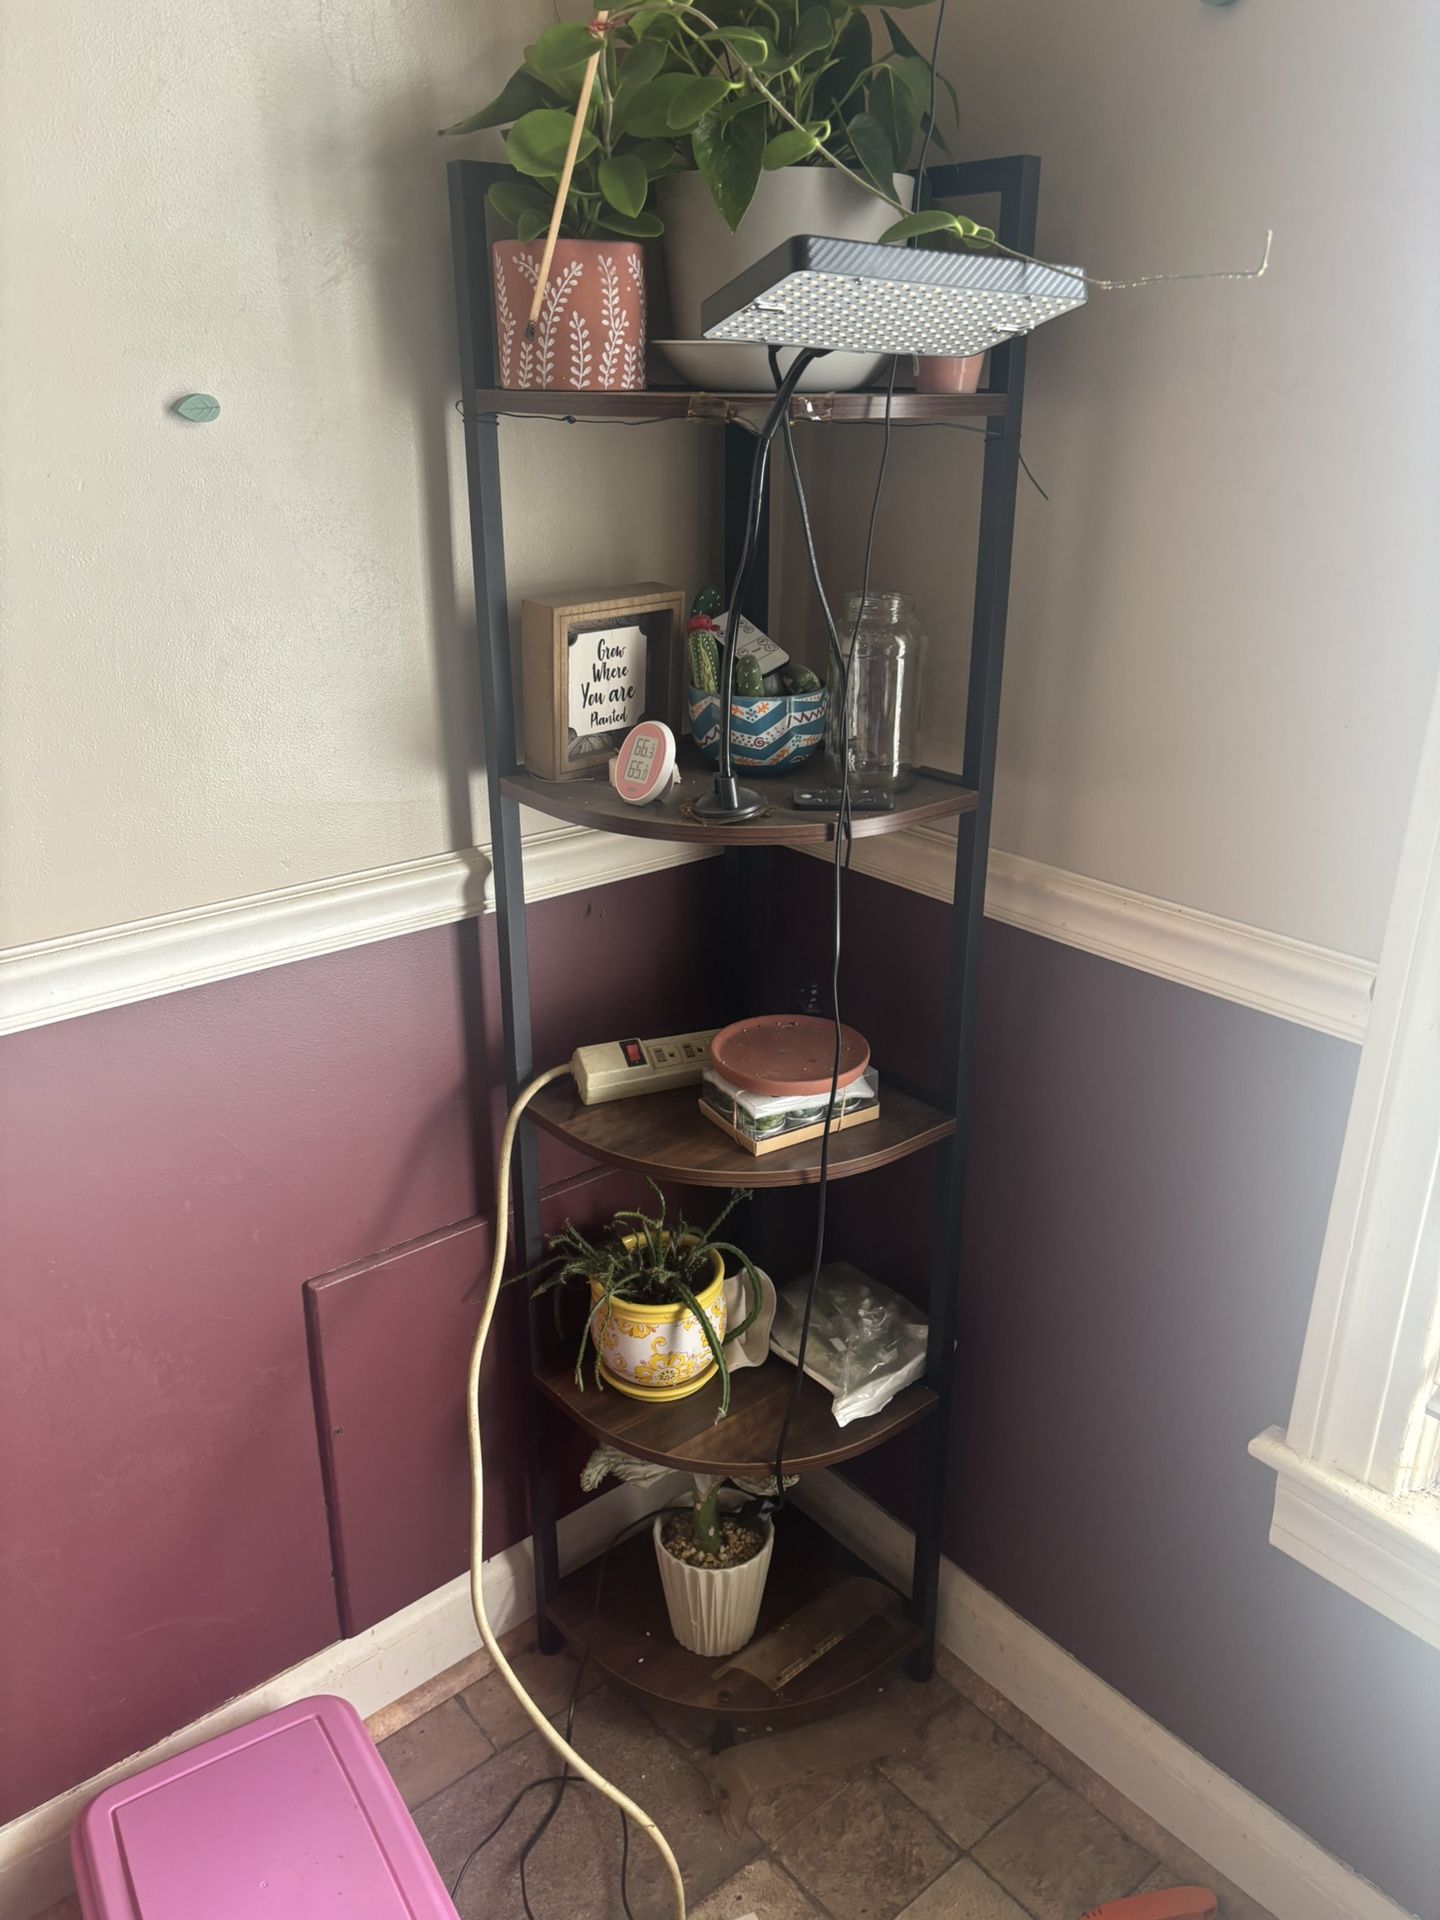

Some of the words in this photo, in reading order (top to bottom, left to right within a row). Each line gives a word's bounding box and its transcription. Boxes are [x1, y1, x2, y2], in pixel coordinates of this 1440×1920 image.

[597, 638, 627, 661] Grow
[592, 662, 629, 683] Where
[581, 682, 605, 709] You
[608, 685, 636, 702] are
[590, 706, 628, 728] Planted
